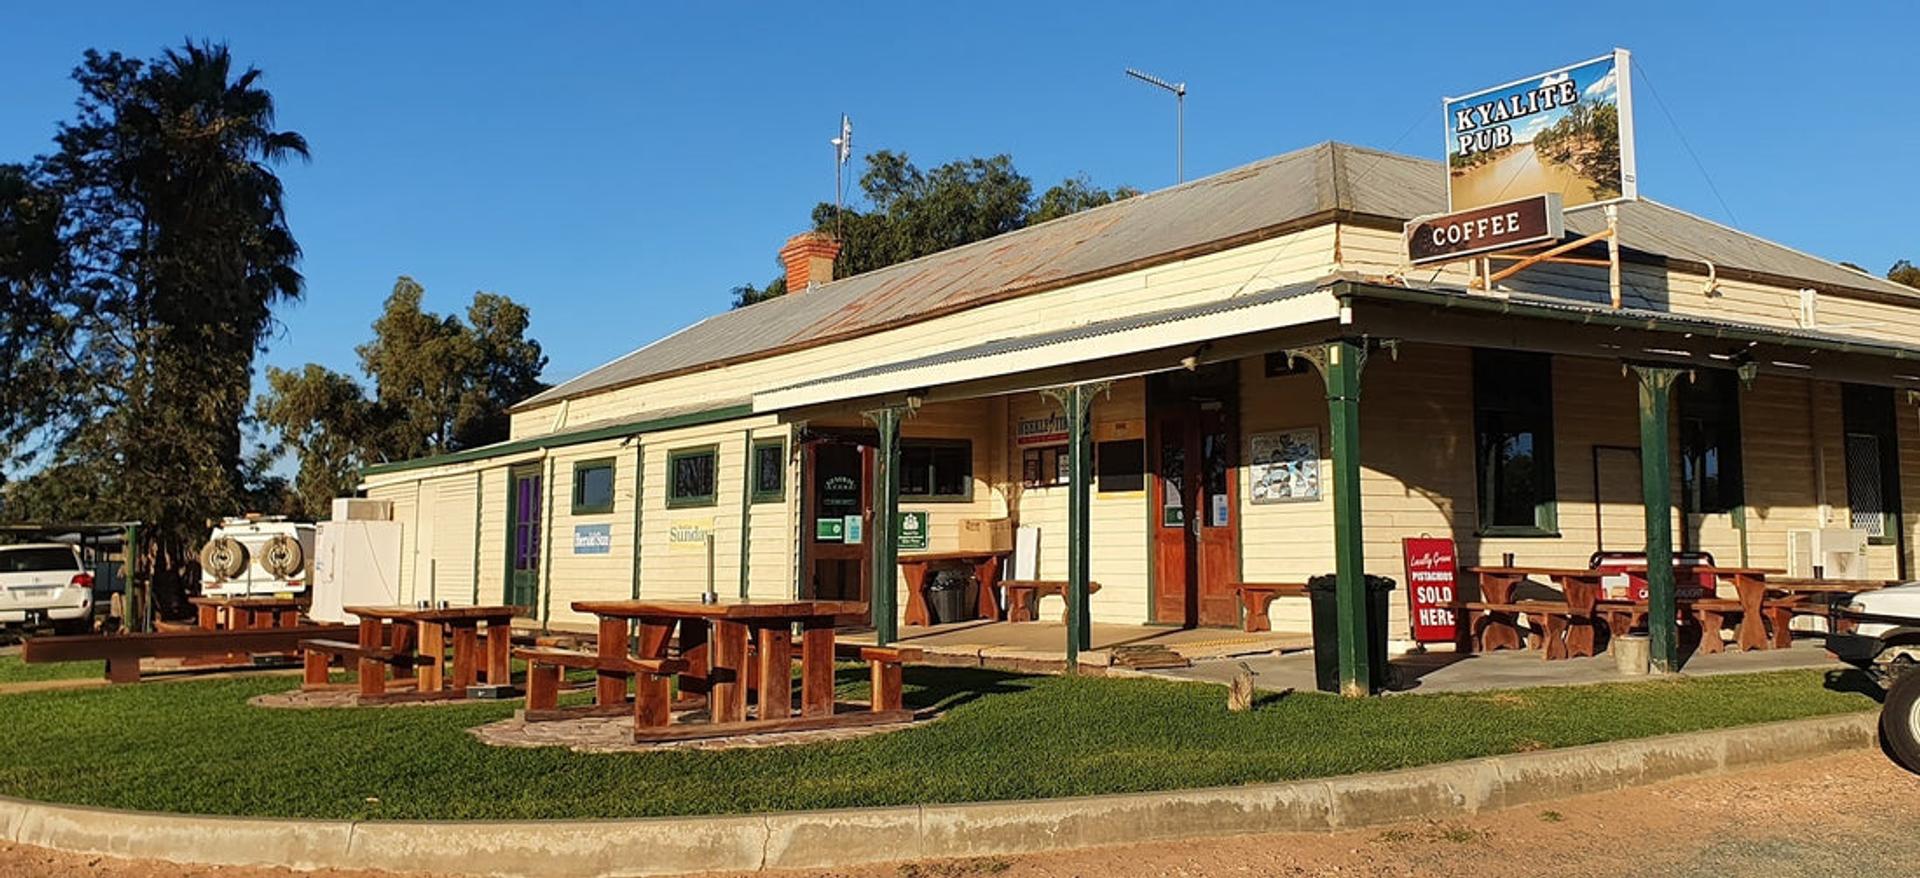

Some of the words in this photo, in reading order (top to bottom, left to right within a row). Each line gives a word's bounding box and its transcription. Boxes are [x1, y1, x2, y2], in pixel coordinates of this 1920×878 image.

[1455, 80, 1579, 132] KYALITE
[1457, 125, 1513, 156] PUB
[1432, 212, 1521, 247] COFFEE
[1412, 572, 1453, 582] PISTACHIOS
[1417, 586, 1453, 604] SOLD
[1419, 608, 1456, 626] HERE
